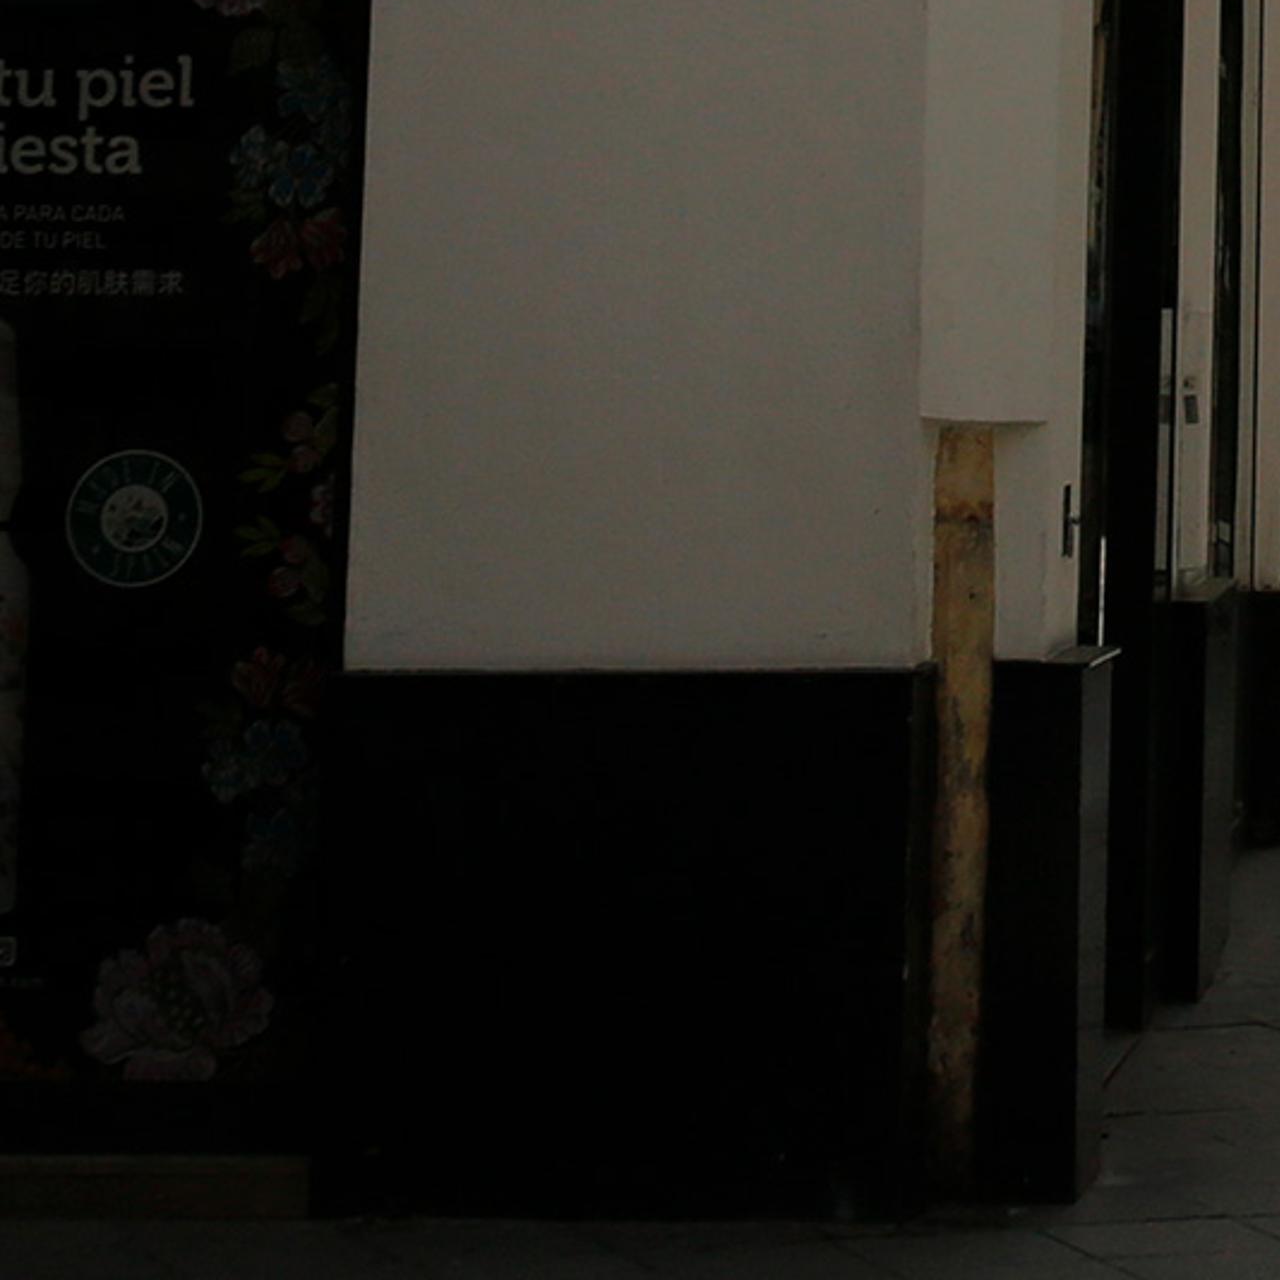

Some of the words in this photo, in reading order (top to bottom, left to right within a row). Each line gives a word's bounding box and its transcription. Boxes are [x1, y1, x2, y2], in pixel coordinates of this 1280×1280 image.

[0, 57, 57, 108] tu
[75, 53, 196, 122] piel
[13, 203, 66, 223] PARA
[70, 203, 127, 223] CADA
[32, 230, 57, 249] TU
[62, 230, 107, 249] PIEL
